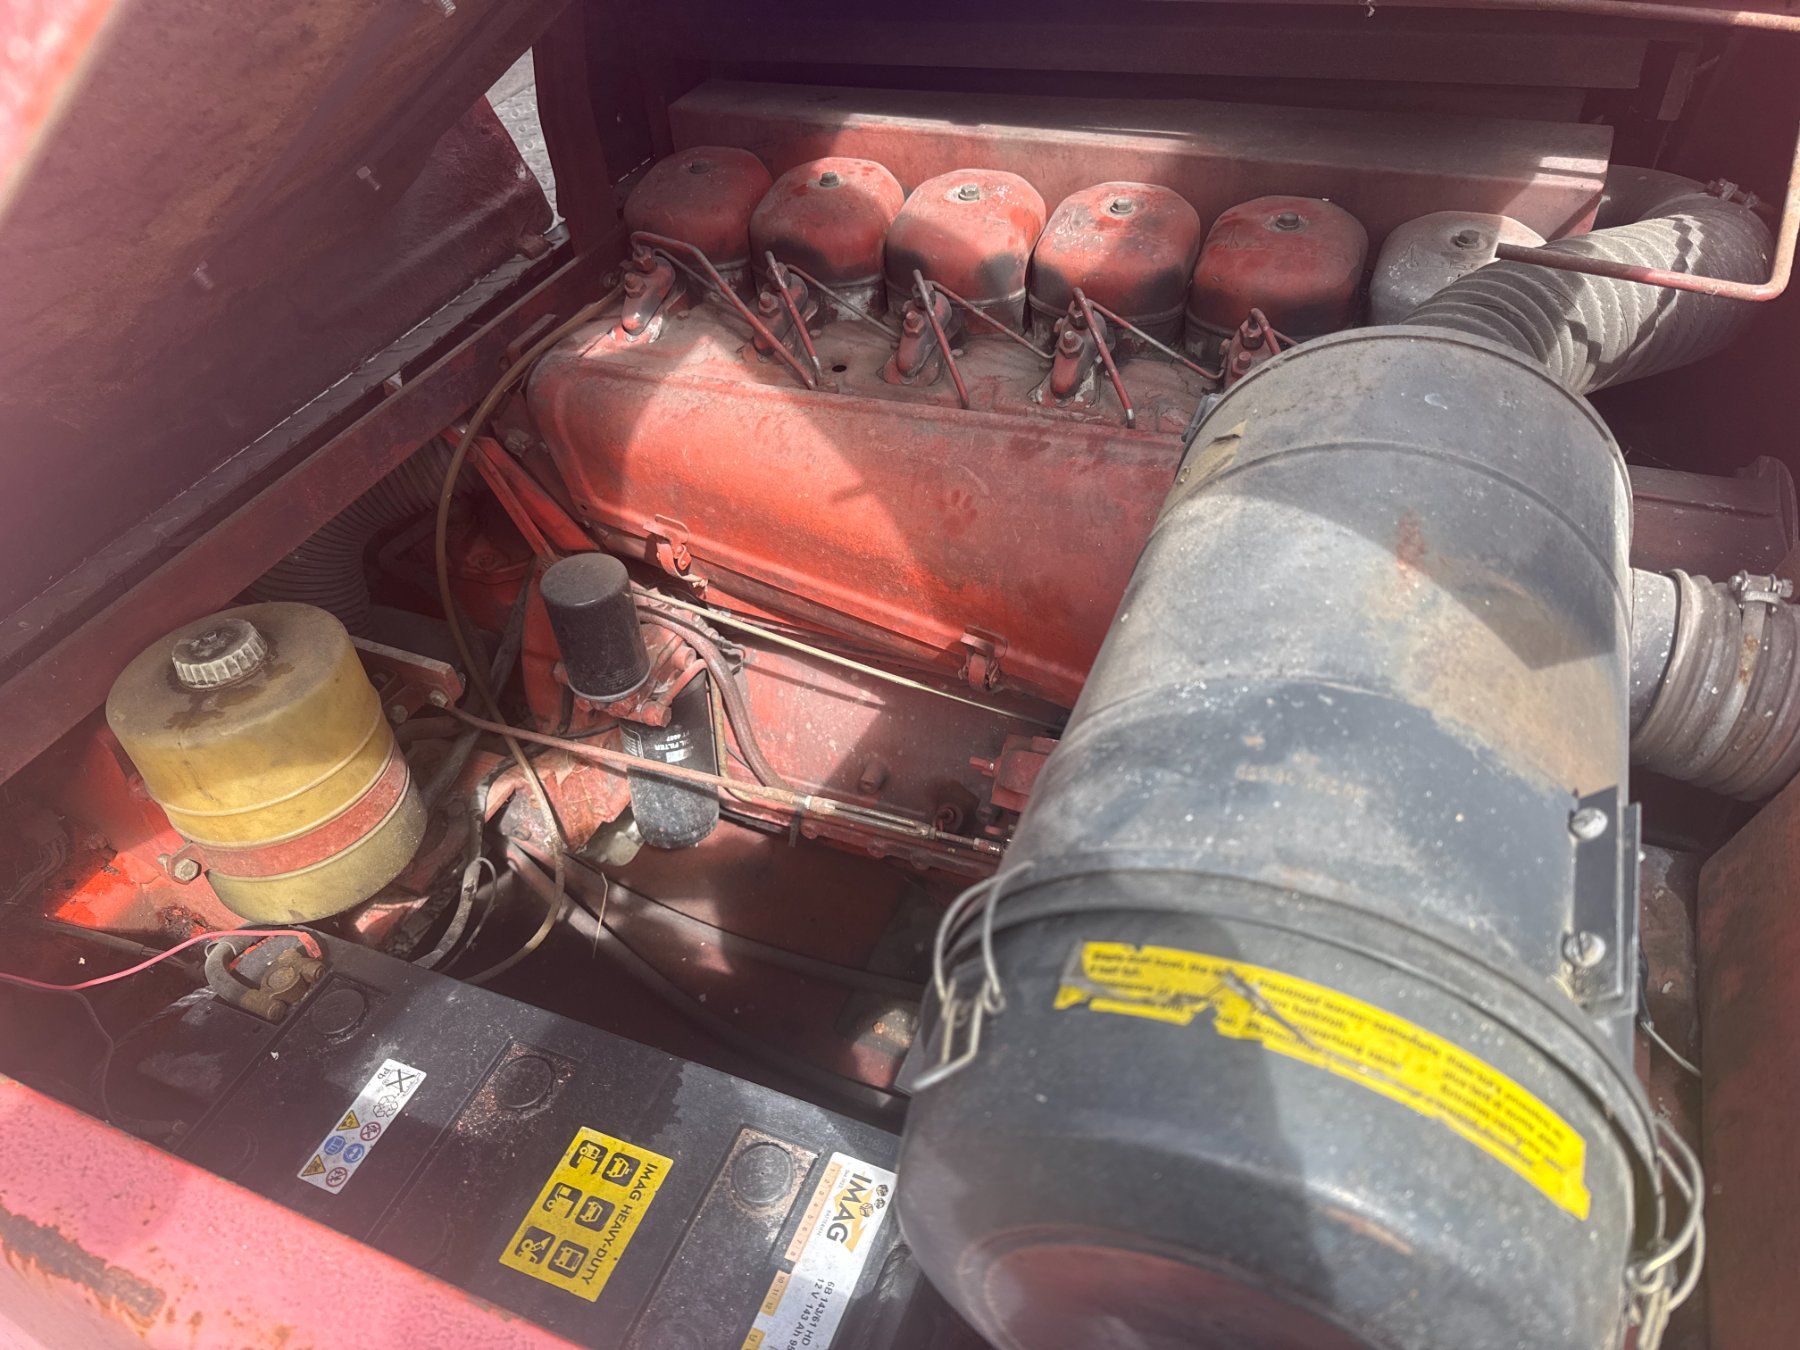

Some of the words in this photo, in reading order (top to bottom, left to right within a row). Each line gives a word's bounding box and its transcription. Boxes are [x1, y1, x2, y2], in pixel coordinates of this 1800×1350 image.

[654, 742, 679, 750] FILTER
[377, 1067, 391, 1079] Pb
[629, 1162, 658, 1202] IMAG
[826, 1173, 872, 1244] IMAG
[581, 1204, 633, 1285] HEAVY-DUTY
[814, 1278, 825, 1289] 12
[824, 1281, 835, 1295] 6B
[811, 1291, 820, 1299] V
[800, 1303, 814, 1321] 143
[809, 1297, 828, 1328] 143/61
[793, 1321, 805, 1337] Ah
[801, 1330, 814, 1346] HD
